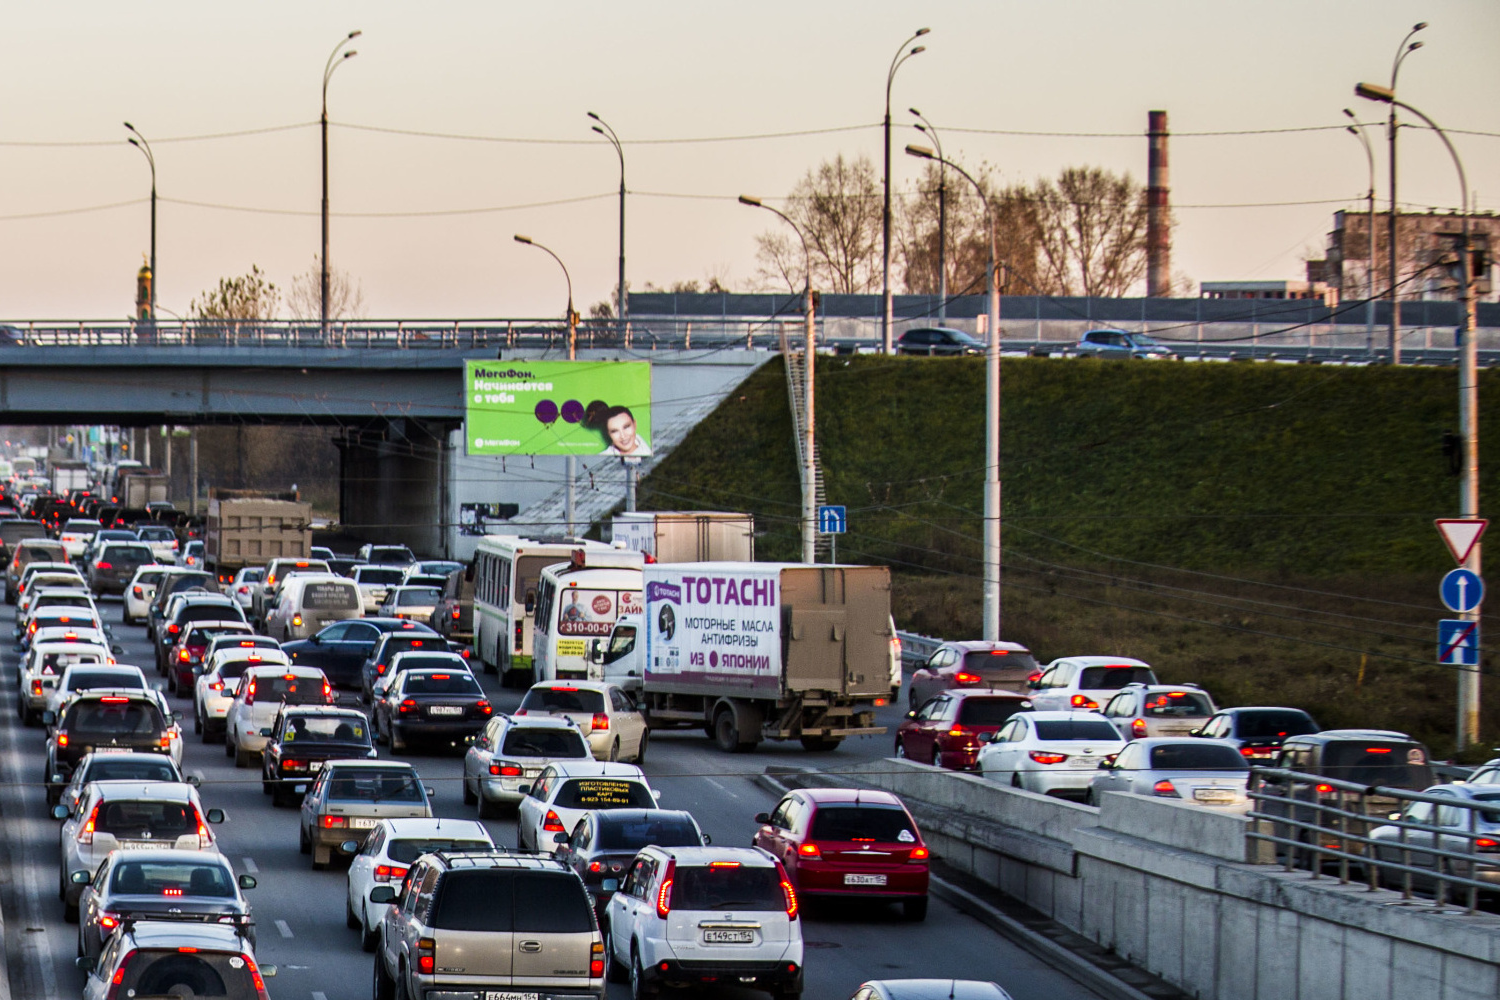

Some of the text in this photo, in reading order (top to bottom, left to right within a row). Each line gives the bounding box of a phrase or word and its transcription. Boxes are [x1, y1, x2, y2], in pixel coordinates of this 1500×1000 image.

[474, 379, 554, 392] Начинается
[474, 391, 516, 404] с тебя
[659, 587, 680, 599] TOTACHI
[681, 576, 776, 607] TOTACHI
[685, 617, 775, 633] МОТОРНЫЕ МАСЛА
[701, 633, 759, 647] АНТИФРИЗЫ
[690, 651, 770, 670] ИЗ ЯПОНИИ
[706, 931, 752, 940] Е149СТ 154
[523, 993, 537, 1000] 154
